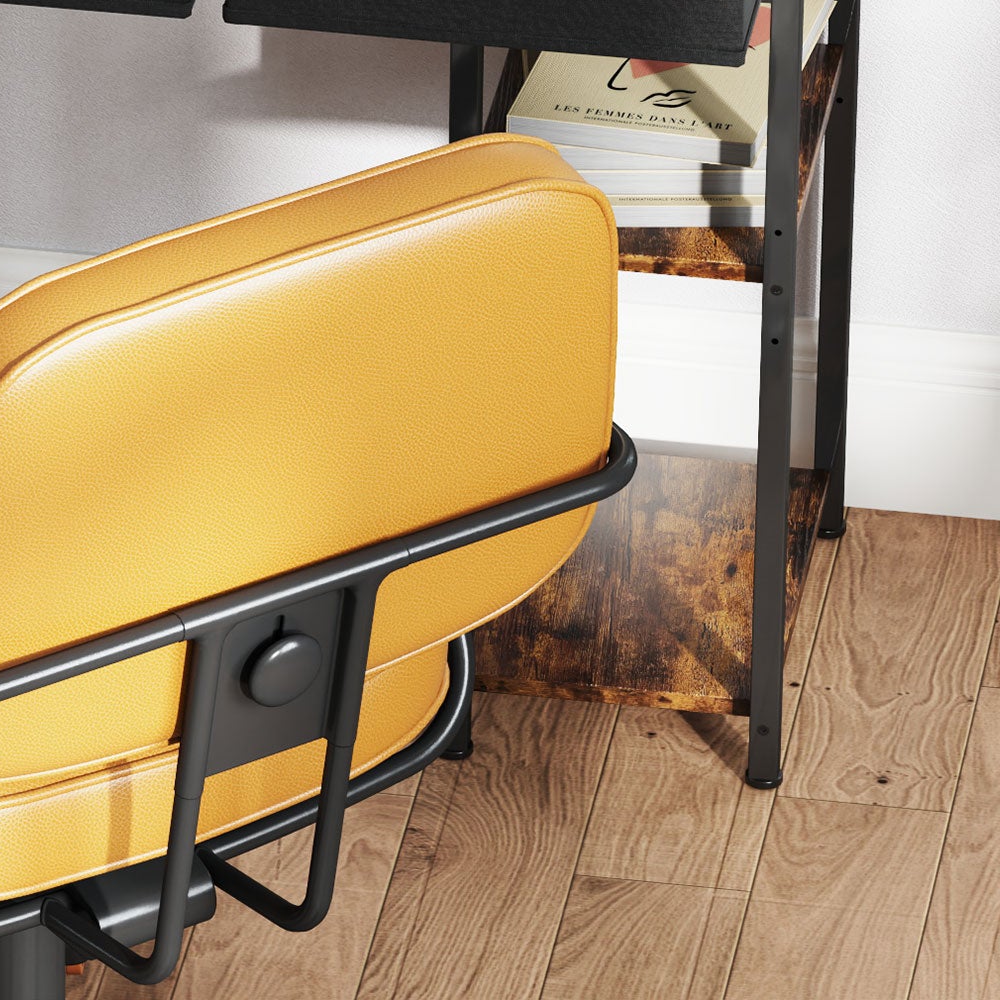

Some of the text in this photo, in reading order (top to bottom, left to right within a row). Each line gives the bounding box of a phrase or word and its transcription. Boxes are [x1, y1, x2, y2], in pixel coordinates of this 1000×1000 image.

[554, 104, 734, 131] LES FEMMES DANS L'ART
